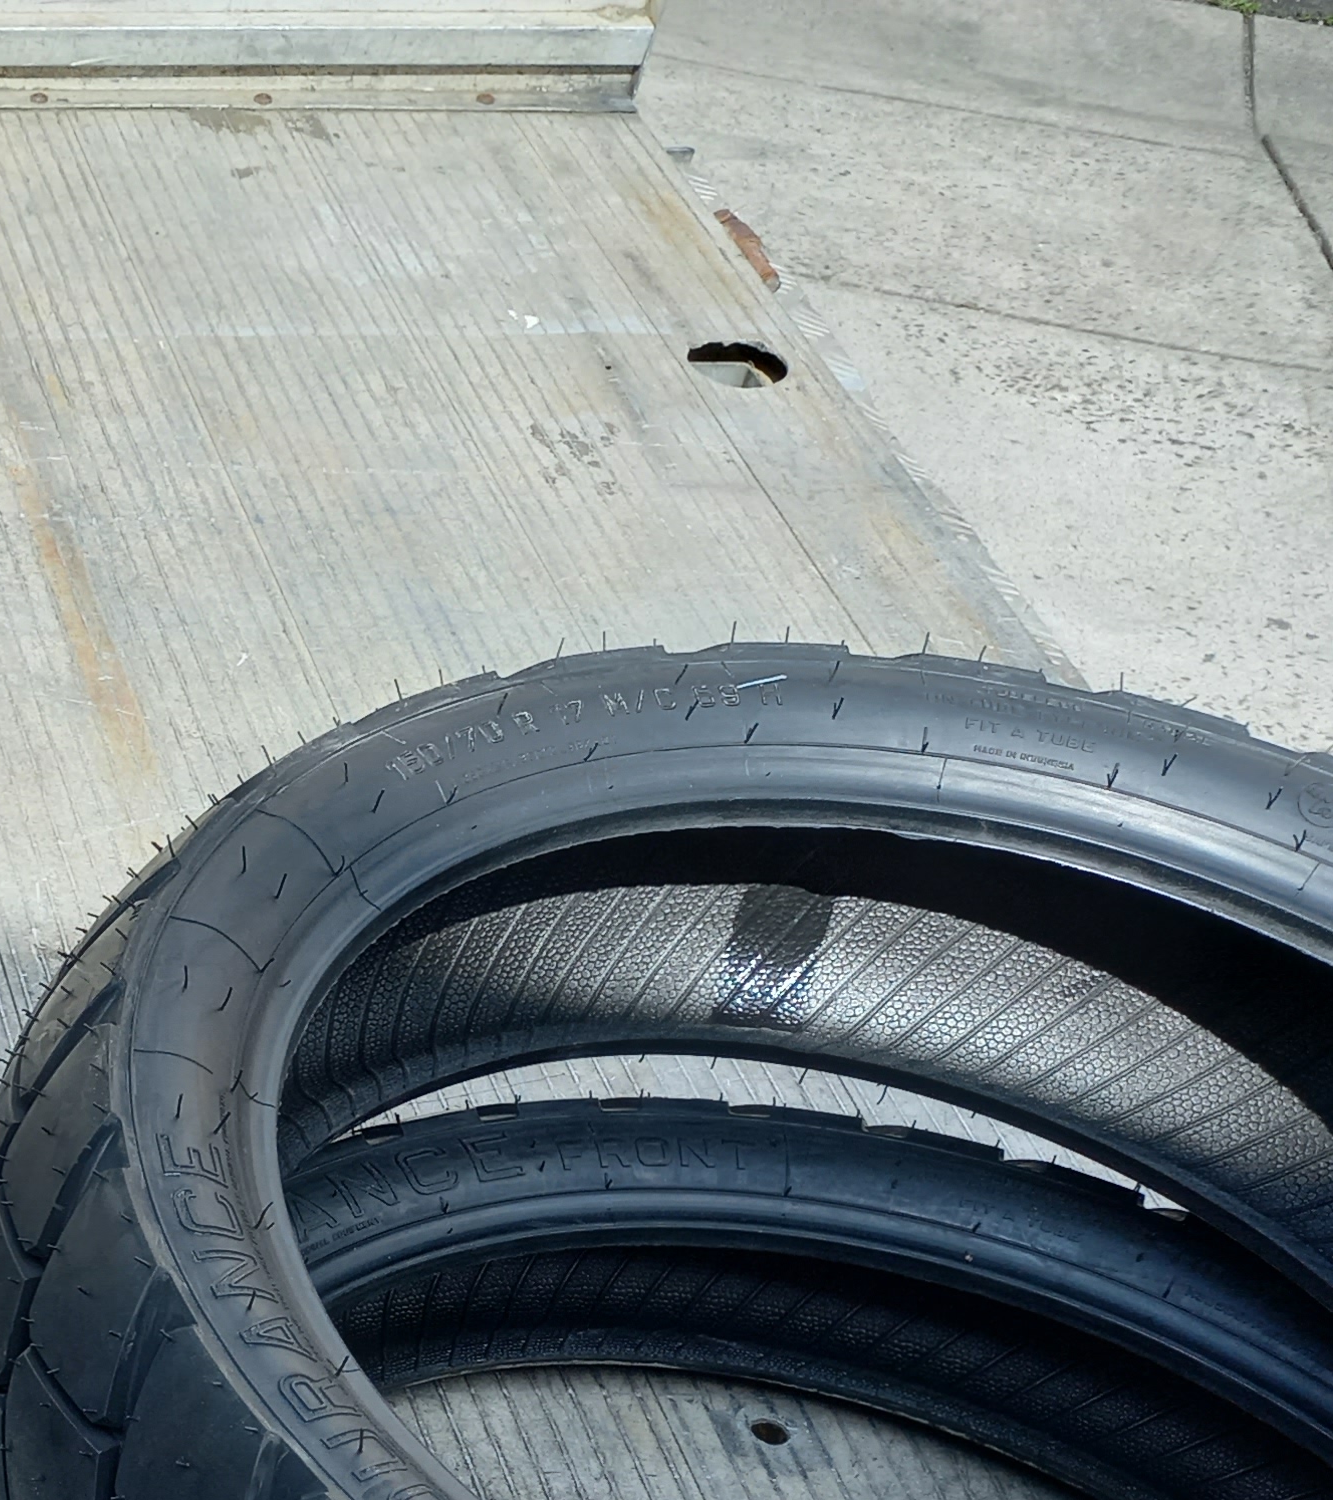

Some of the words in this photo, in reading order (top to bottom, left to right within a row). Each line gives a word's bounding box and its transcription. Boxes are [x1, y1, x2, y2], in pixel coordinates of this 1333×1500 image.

[513, 711, 540, 736] R
[965, 717, 997, 734] FIT
[1010, 725, 1026, 739] A
[1037, 729, 1097, 754] TUBE
[284, 1131, 527, 1241] ANCE
[557, 1135, 757, 1173] FRONT
